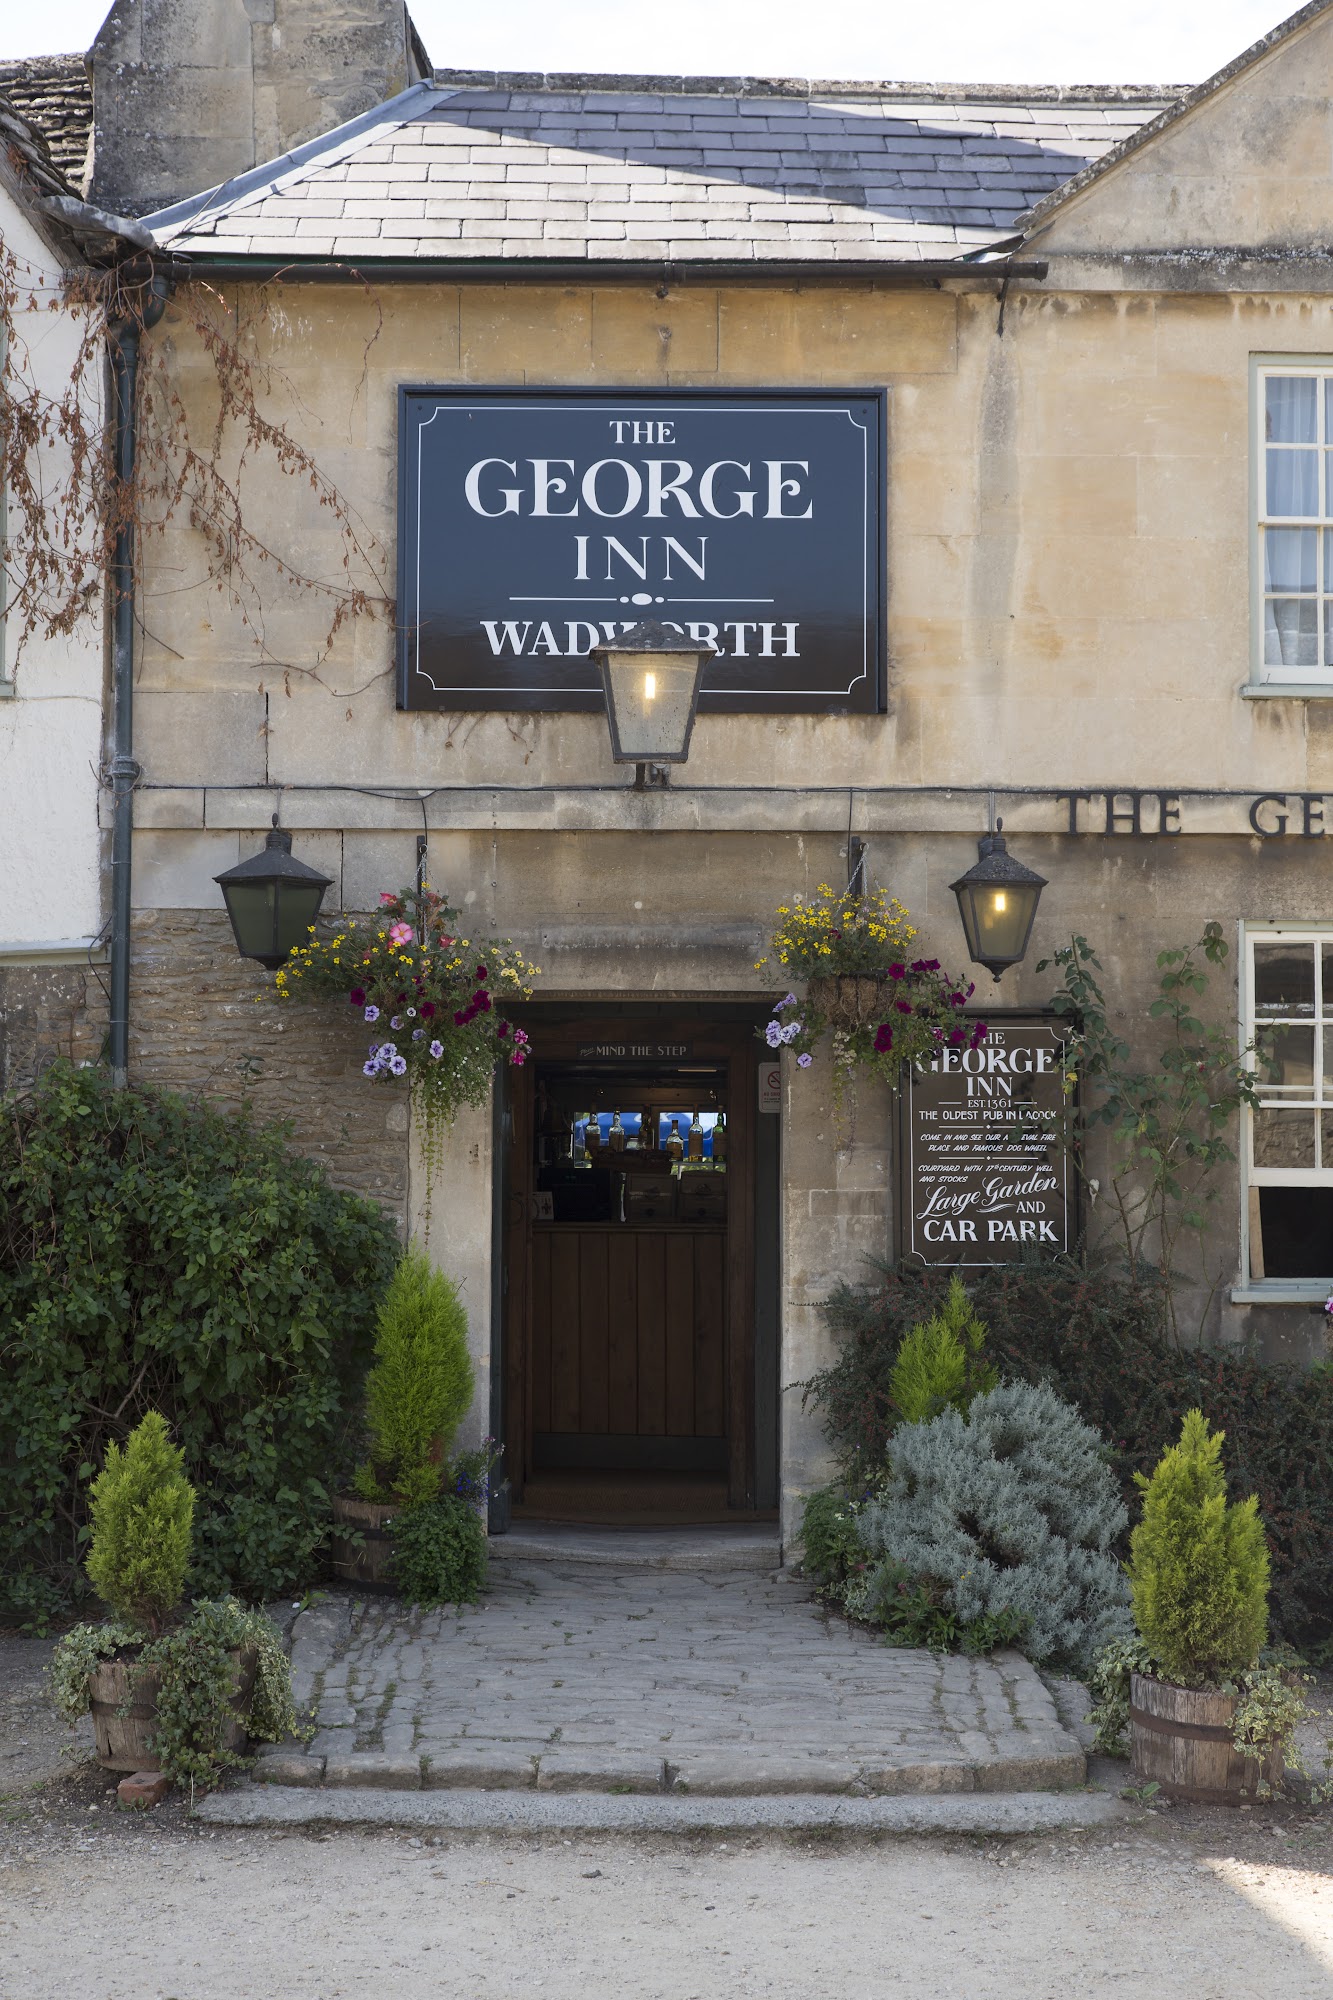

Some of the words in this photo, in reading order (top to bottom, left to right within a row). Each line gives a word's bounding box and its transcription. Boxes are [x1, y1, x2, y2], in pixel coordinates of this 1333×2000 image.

[609, 421, 676, 444] THE
[464, 458, 813, 519] GEORGE
[573, 536, 709, 580] INN
[1056, 793, 1182, 836] THE
[596, 1045, 626, 1056] MIND
[629, 1045, 653, 1056] THE
[657, 1045, 687, 1056] STEP
[966, 1076, 1013, 1097] INN
[919, 1110, 938, 1121] THE
[942, 1110, 979, 1121] OLDEST
[983, 1110, 1004, 1121] PUB
[1005, 1110, 1017, 1121] IN
[920, 1133, 942, 1141] COME
[943, 1133, 953, 1141] IN
[952, 1133, 968, 1141] AND
[969, 1133, 983, 1141] SEE
[985, 1133, 1002, 1141] OUR
[1040, 1133, 1057, 1141] FIRE
[927, 1144, 951, 1152] PLACE
[952, 1144, 969, 1152] AND
[971, 1144, 1004, 1152] FAMOUS
[1006, 1144, 1022, 1152] DOG
[1023, 1144, 1048, 1152] WHEEL
[937, 1175, 969, 1183] STOCKS
[916, 1185, 981, 1220] Large
[981, 1172, 1060, 1207] Garden
[1016, 1201, 1046, 1214] AND
[923, 1219, 979, 1242] CAR
[987, 1220, 1060, 1242] PARK
